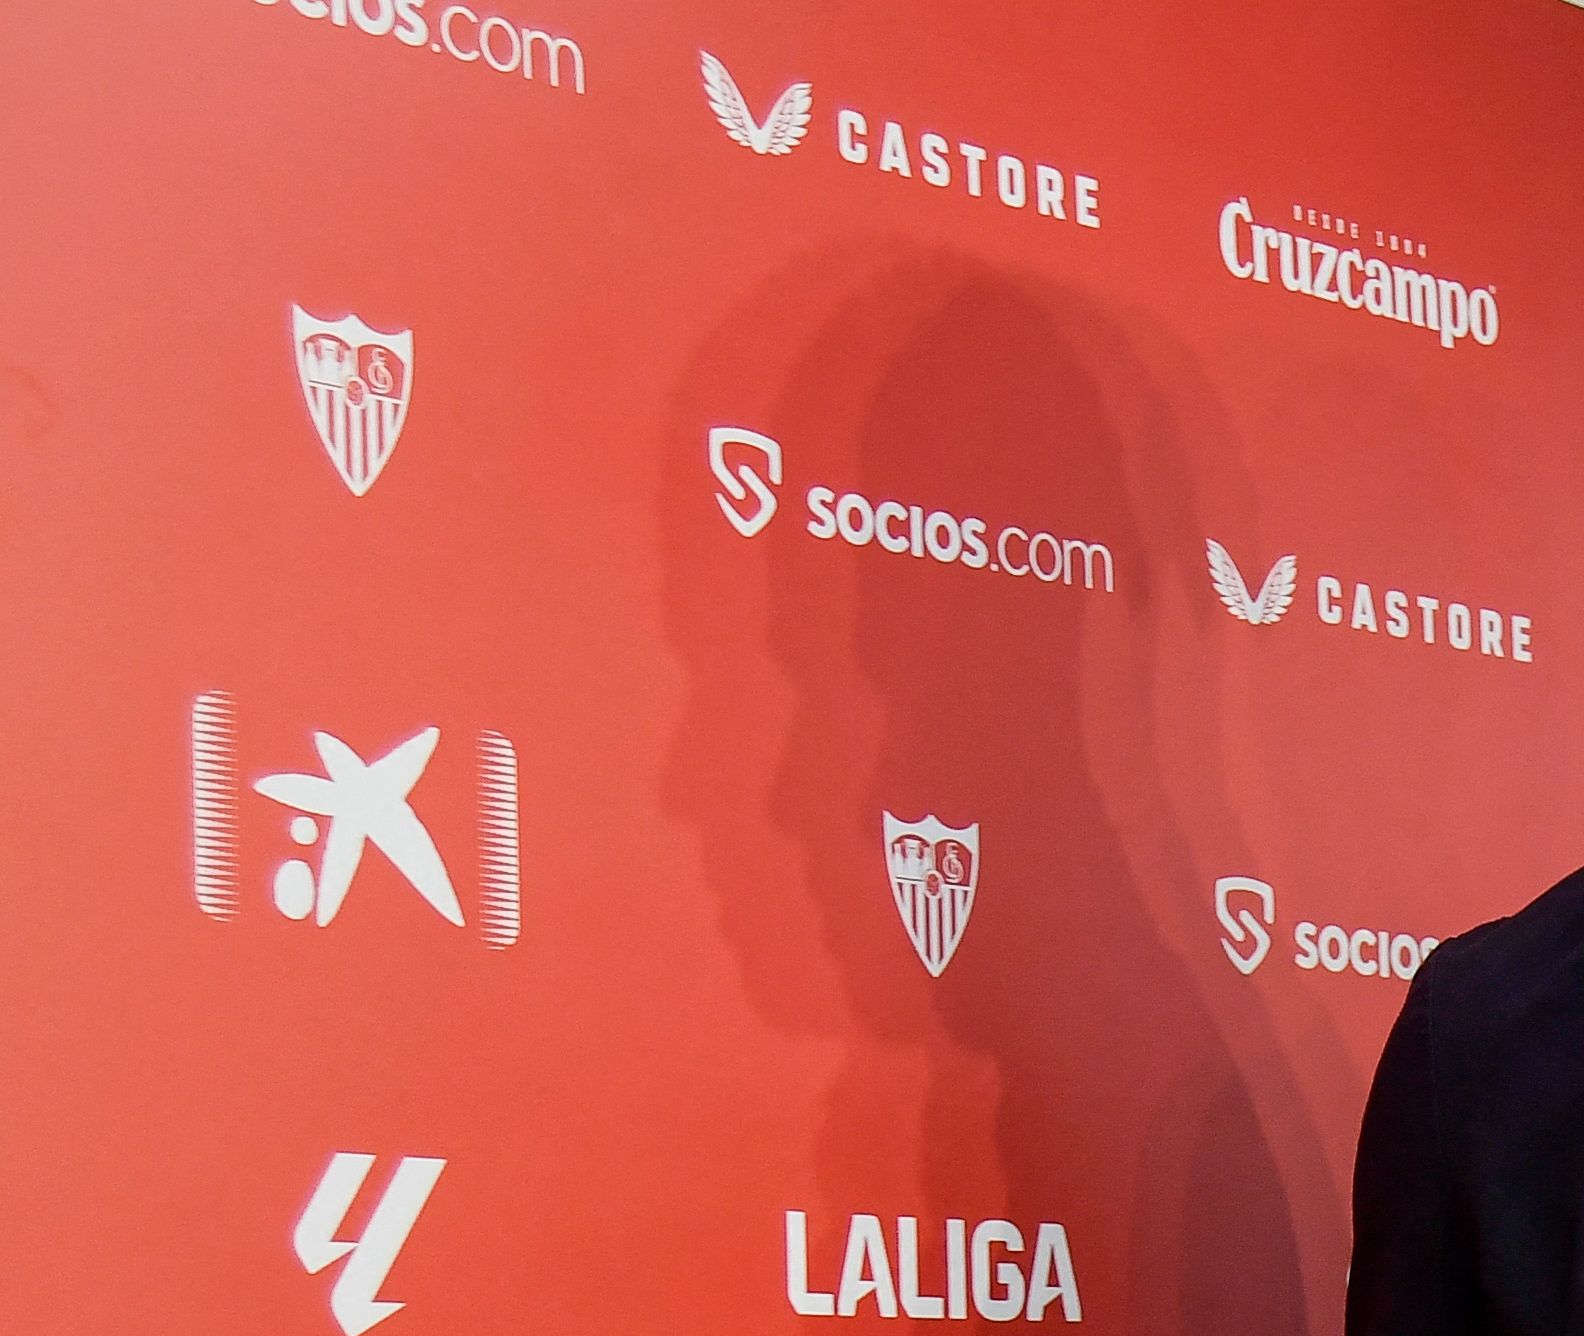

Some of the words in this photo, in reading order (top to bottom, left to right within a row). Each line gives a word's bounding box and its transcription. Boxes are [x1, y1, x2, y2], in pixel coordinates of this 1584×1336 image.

[837, 109, 1100, 229] CASTORE
[1218, 196, 1499, 350] Cruzcampo
[1317, 575, 1534, 663] CASTORE
[785, 1210, 1083, 1322] LALIGA
